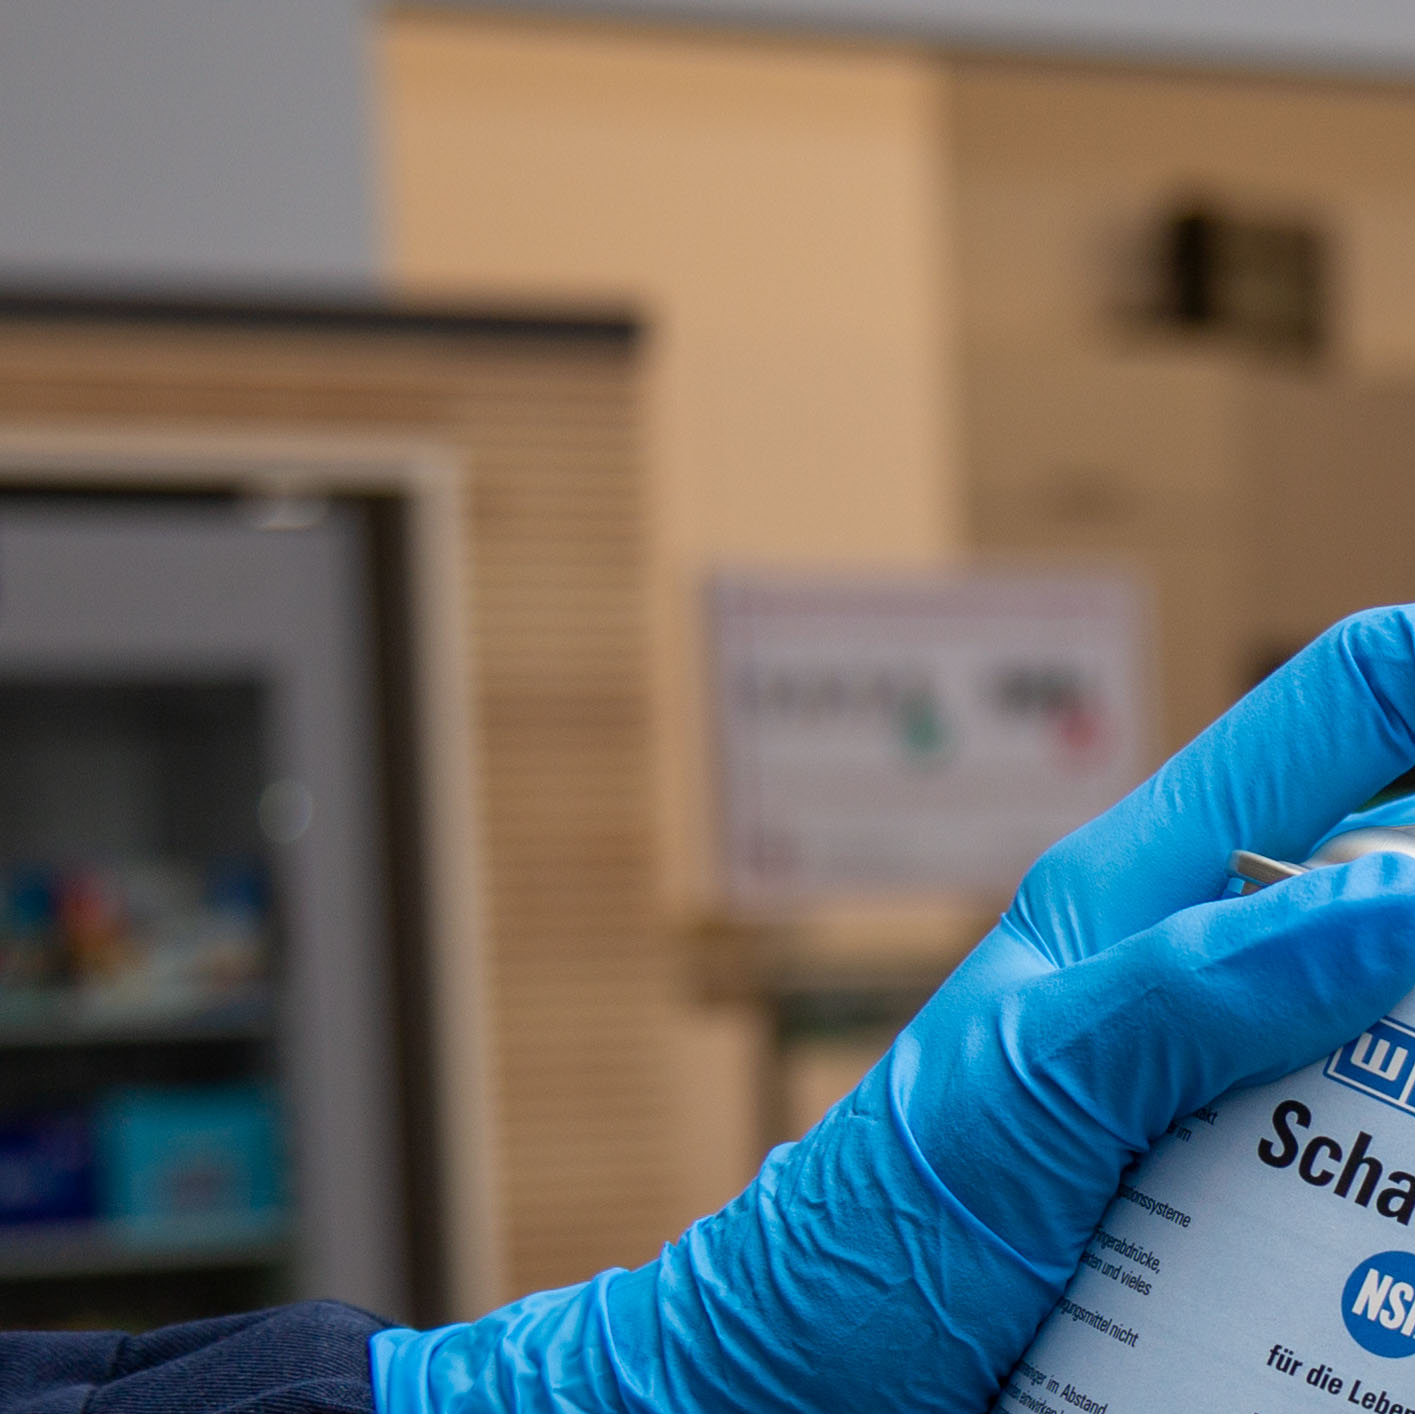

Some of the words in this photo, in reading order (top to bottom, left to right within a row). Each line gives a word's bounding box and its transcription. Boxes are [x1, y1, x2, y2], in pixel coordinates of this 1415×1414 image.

[1101, 1262, 1122, 1280] und
[1120, 1271, 1152, 1296] vieles
[1109, 1324, 1139, 1348] nicht
[1267, 1344, 1303, 1377] für
[1306, 1364, 1344, 1395] die
